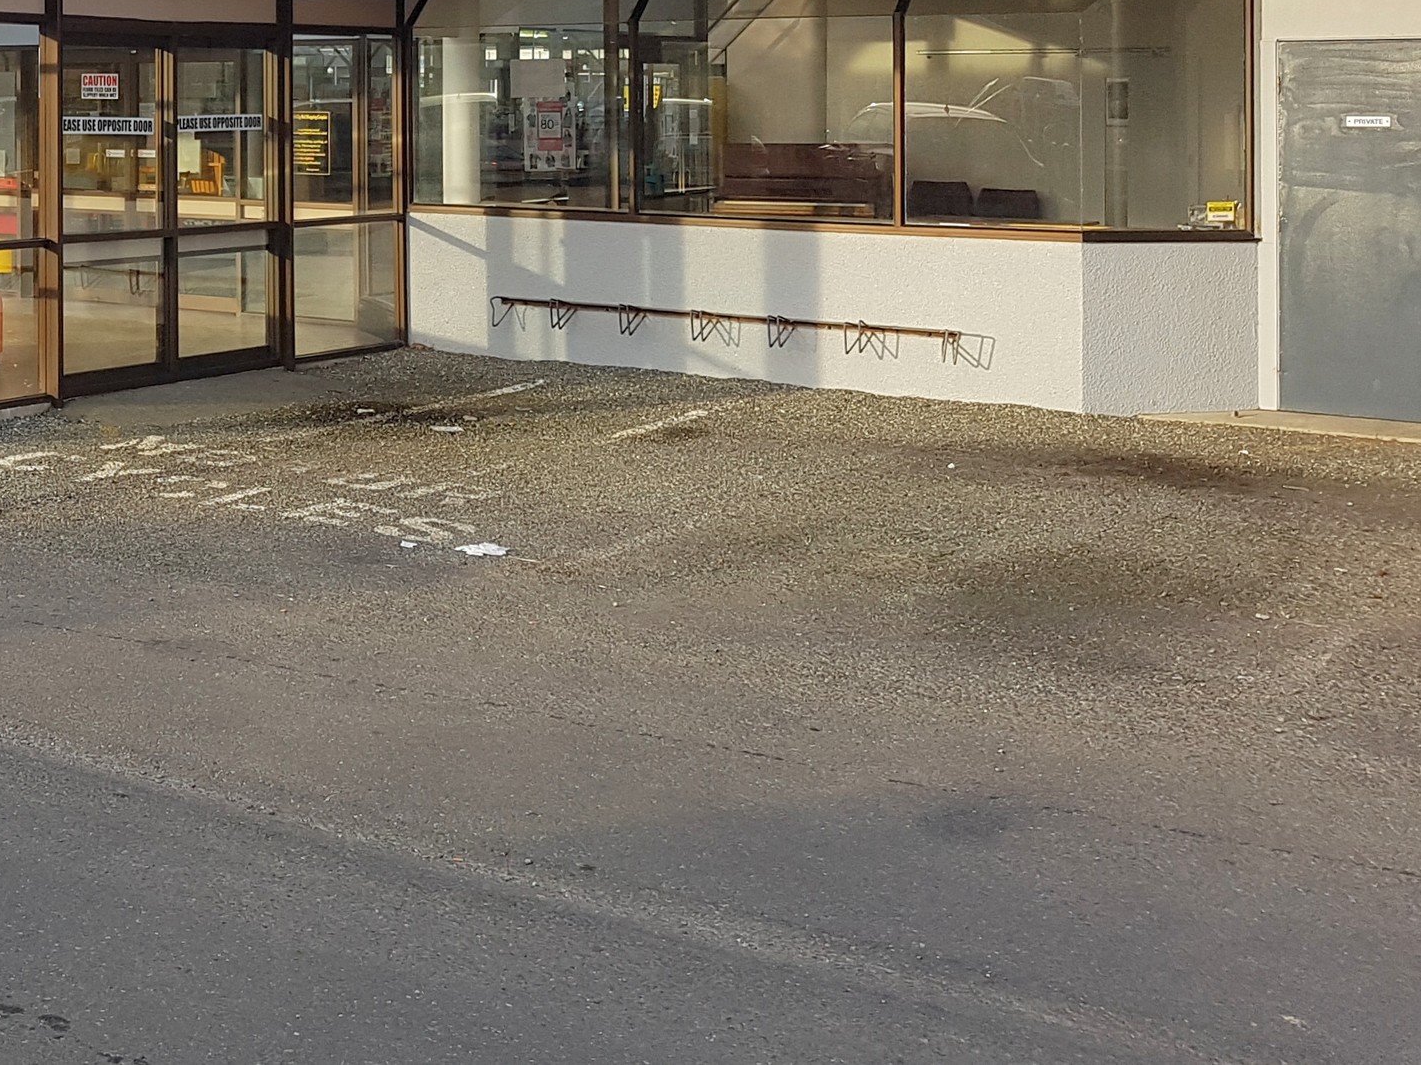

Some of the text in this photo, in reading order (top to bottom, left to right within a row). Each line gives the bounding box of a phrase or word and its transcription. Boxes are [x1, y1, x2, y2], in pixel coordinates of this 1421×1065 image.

[83, 75, 117, 86] CAUTION
[63, 119, 153, 133] EASE USE OPPOSITE DOOR
[199, 117, 211, 129] USE
[212, 116, 243, 129] OPPOSITE
[244, 116, 261, 128] DOOR
